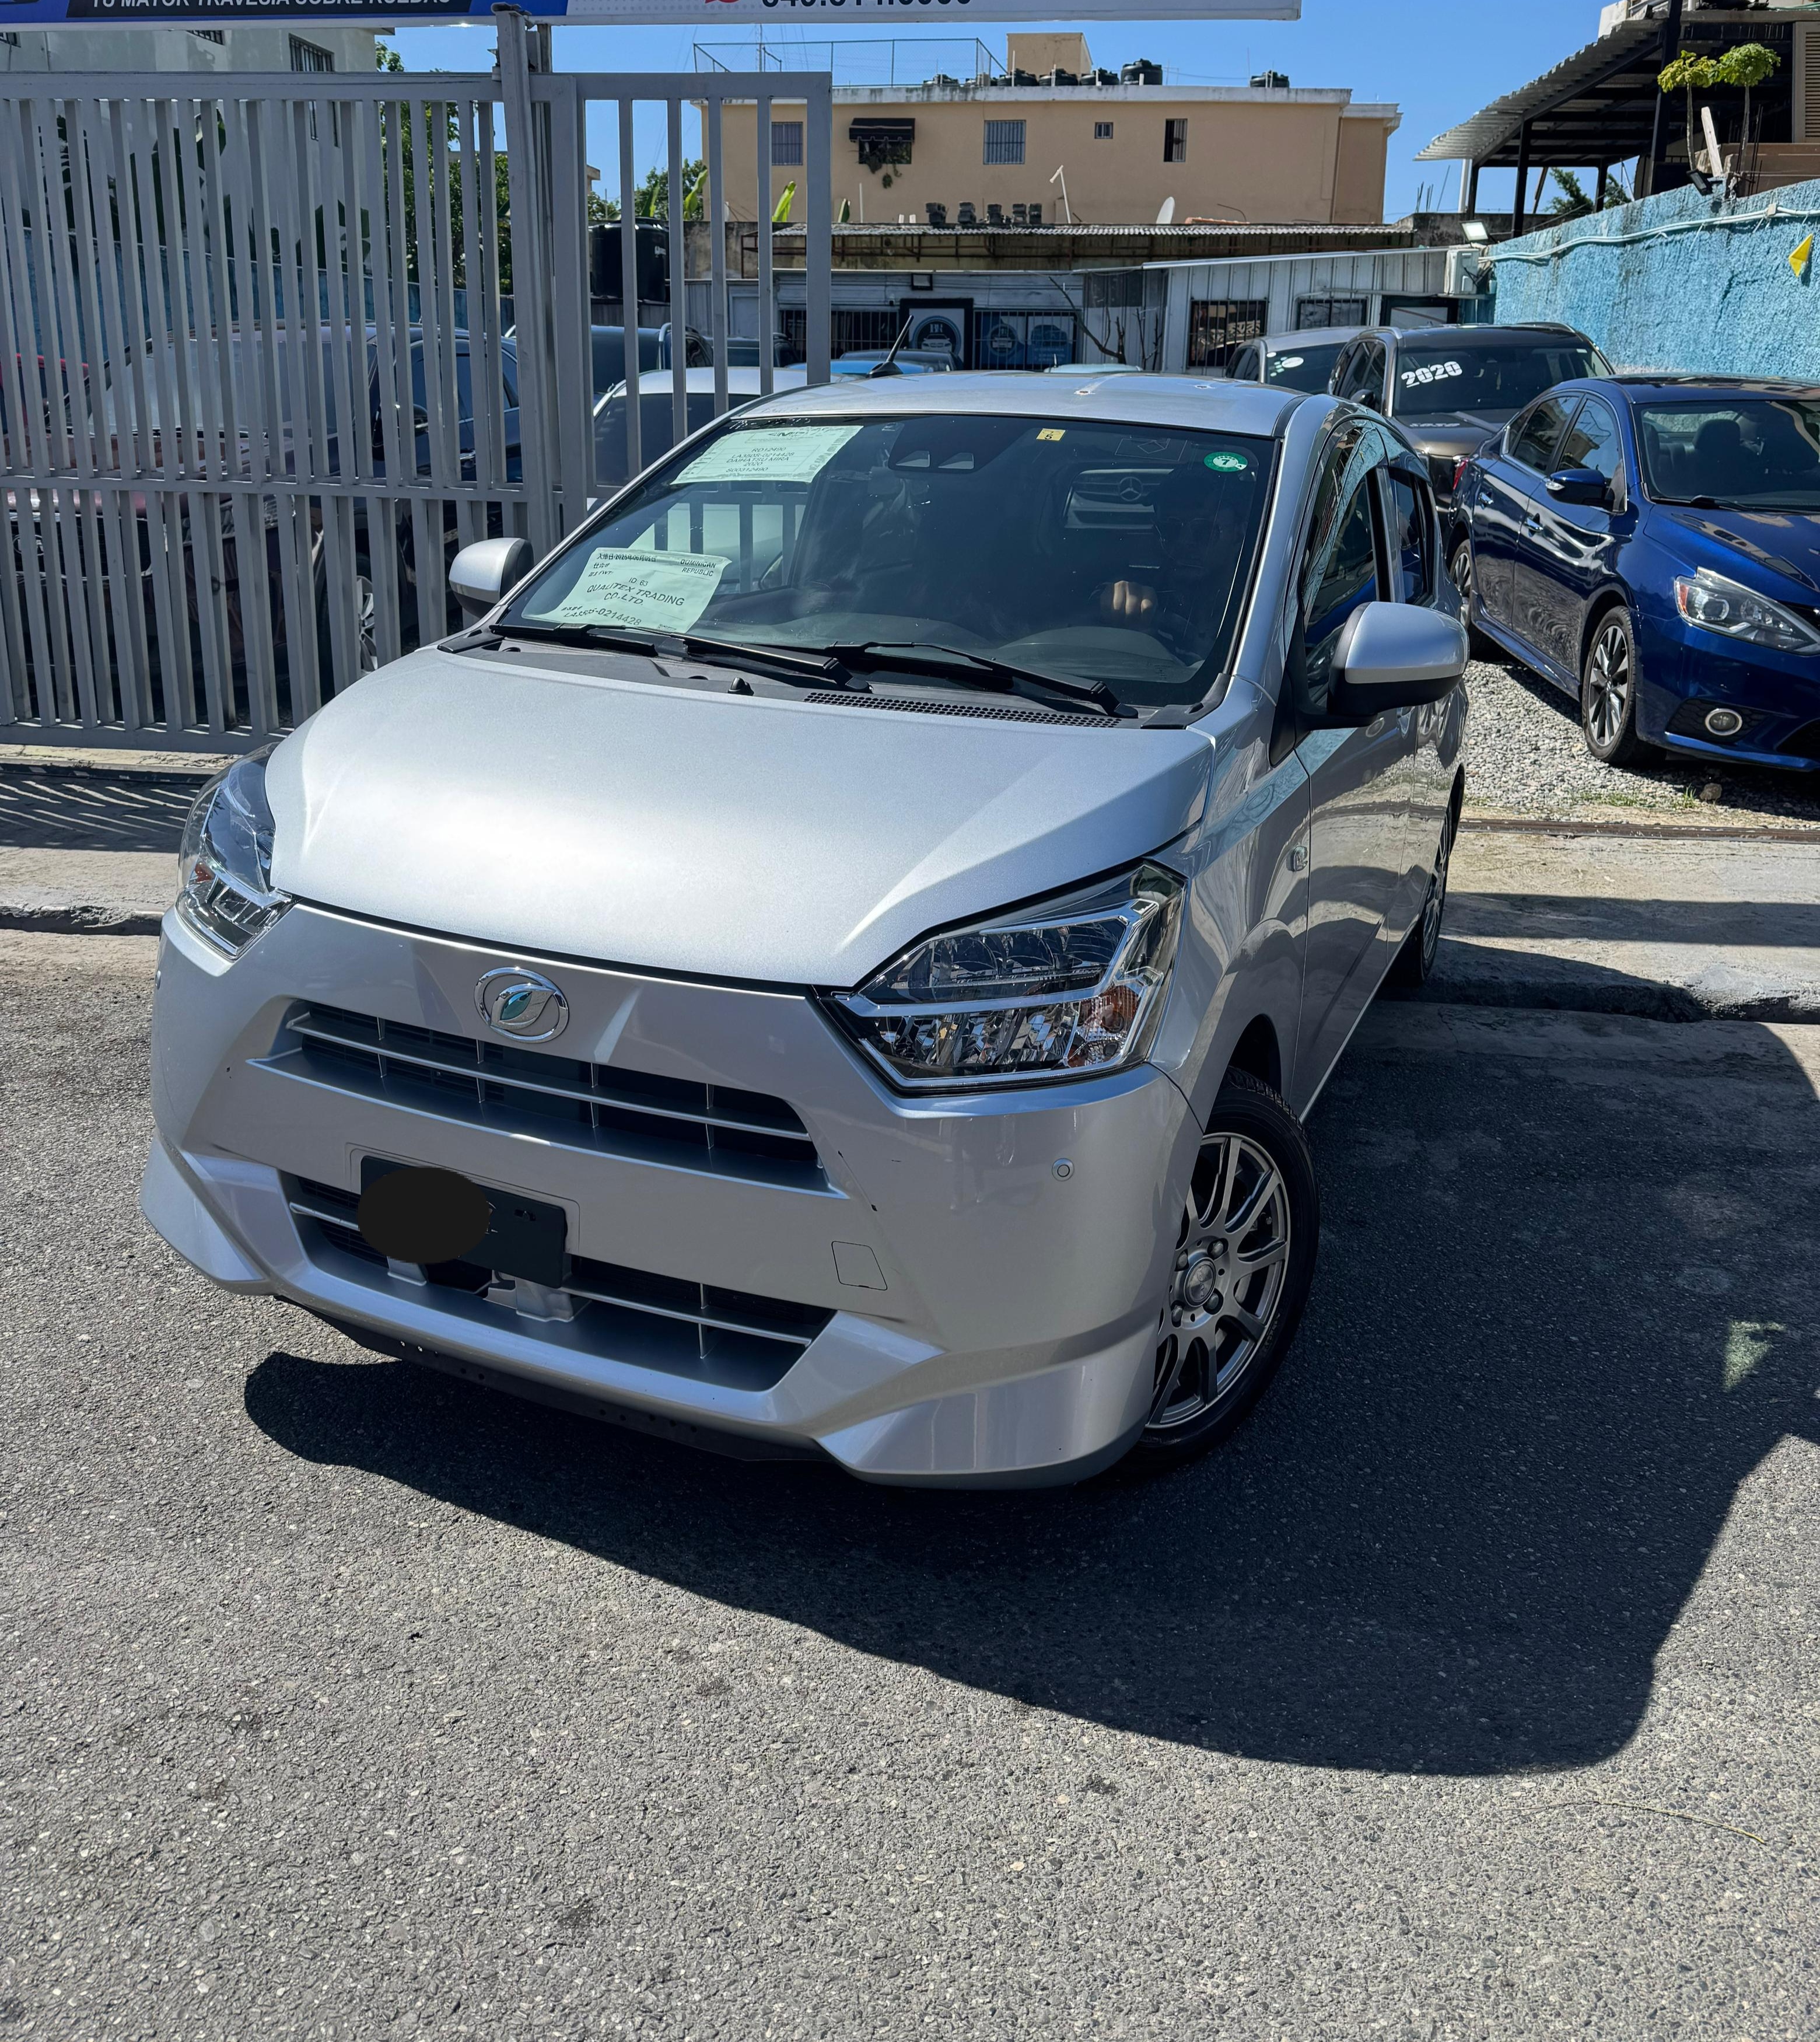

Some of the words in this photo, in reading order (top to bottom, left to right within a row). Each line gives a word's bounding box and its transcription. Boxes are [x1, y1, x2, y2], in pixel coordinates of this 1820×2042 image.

[1401, 361, 1462, 388] 2020
[680, 559, 717, 568] DOMINICAN
[682, 567, 715, 576] REPUBLIC
[587, 582, 636, 593] QUALITEX
[636, 589, 685, 606] TRADING
